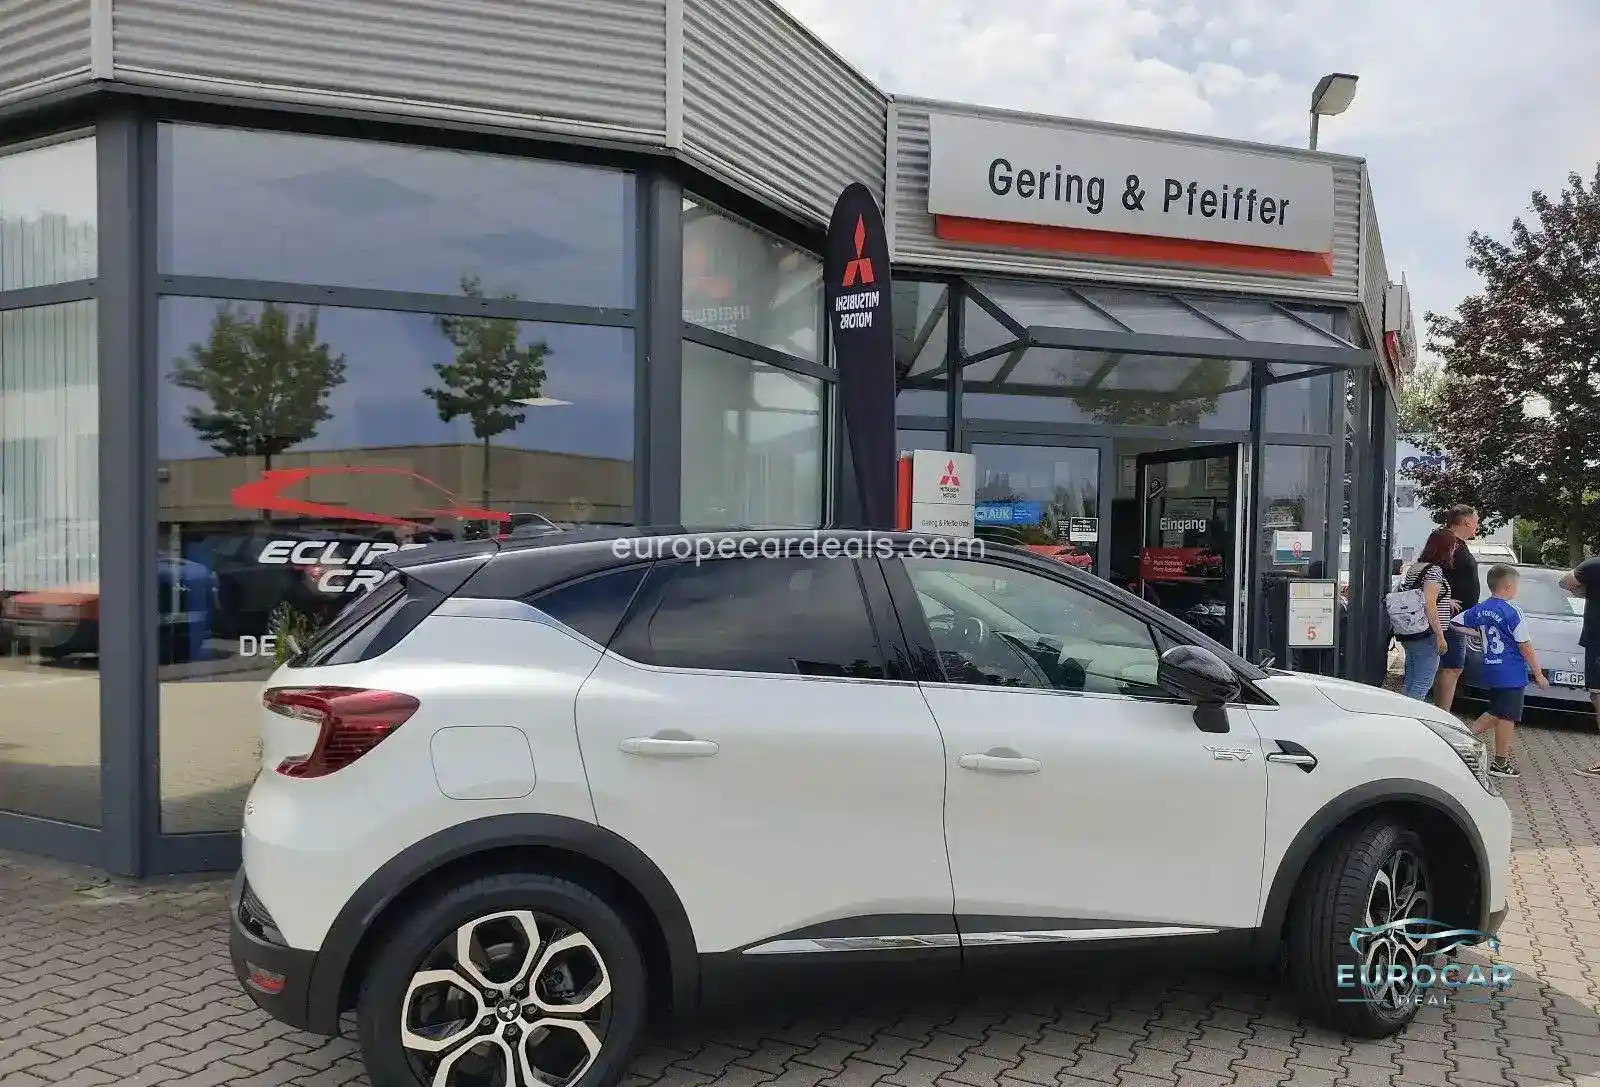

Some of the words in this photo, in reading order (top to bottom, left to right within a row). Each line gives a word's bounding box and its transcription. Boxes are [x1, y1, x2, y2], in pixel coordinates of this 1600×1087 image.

[988, 157, 1105, 215] Gering
[1121, 174, 1146, 212] &
[1163, 178, 1290, 226] Pfeiffer
[1159, 517, 1207, 533] Eingang
[258, 540, 427, 566] ECLIP
[317, 569, 400, 593] CR
[1305, 625, 1317, 641] 5
[1480, 624, 1505, 655] 13
[239, 634, 278, 657] DE
[1554, 672, 1563, 682] C
